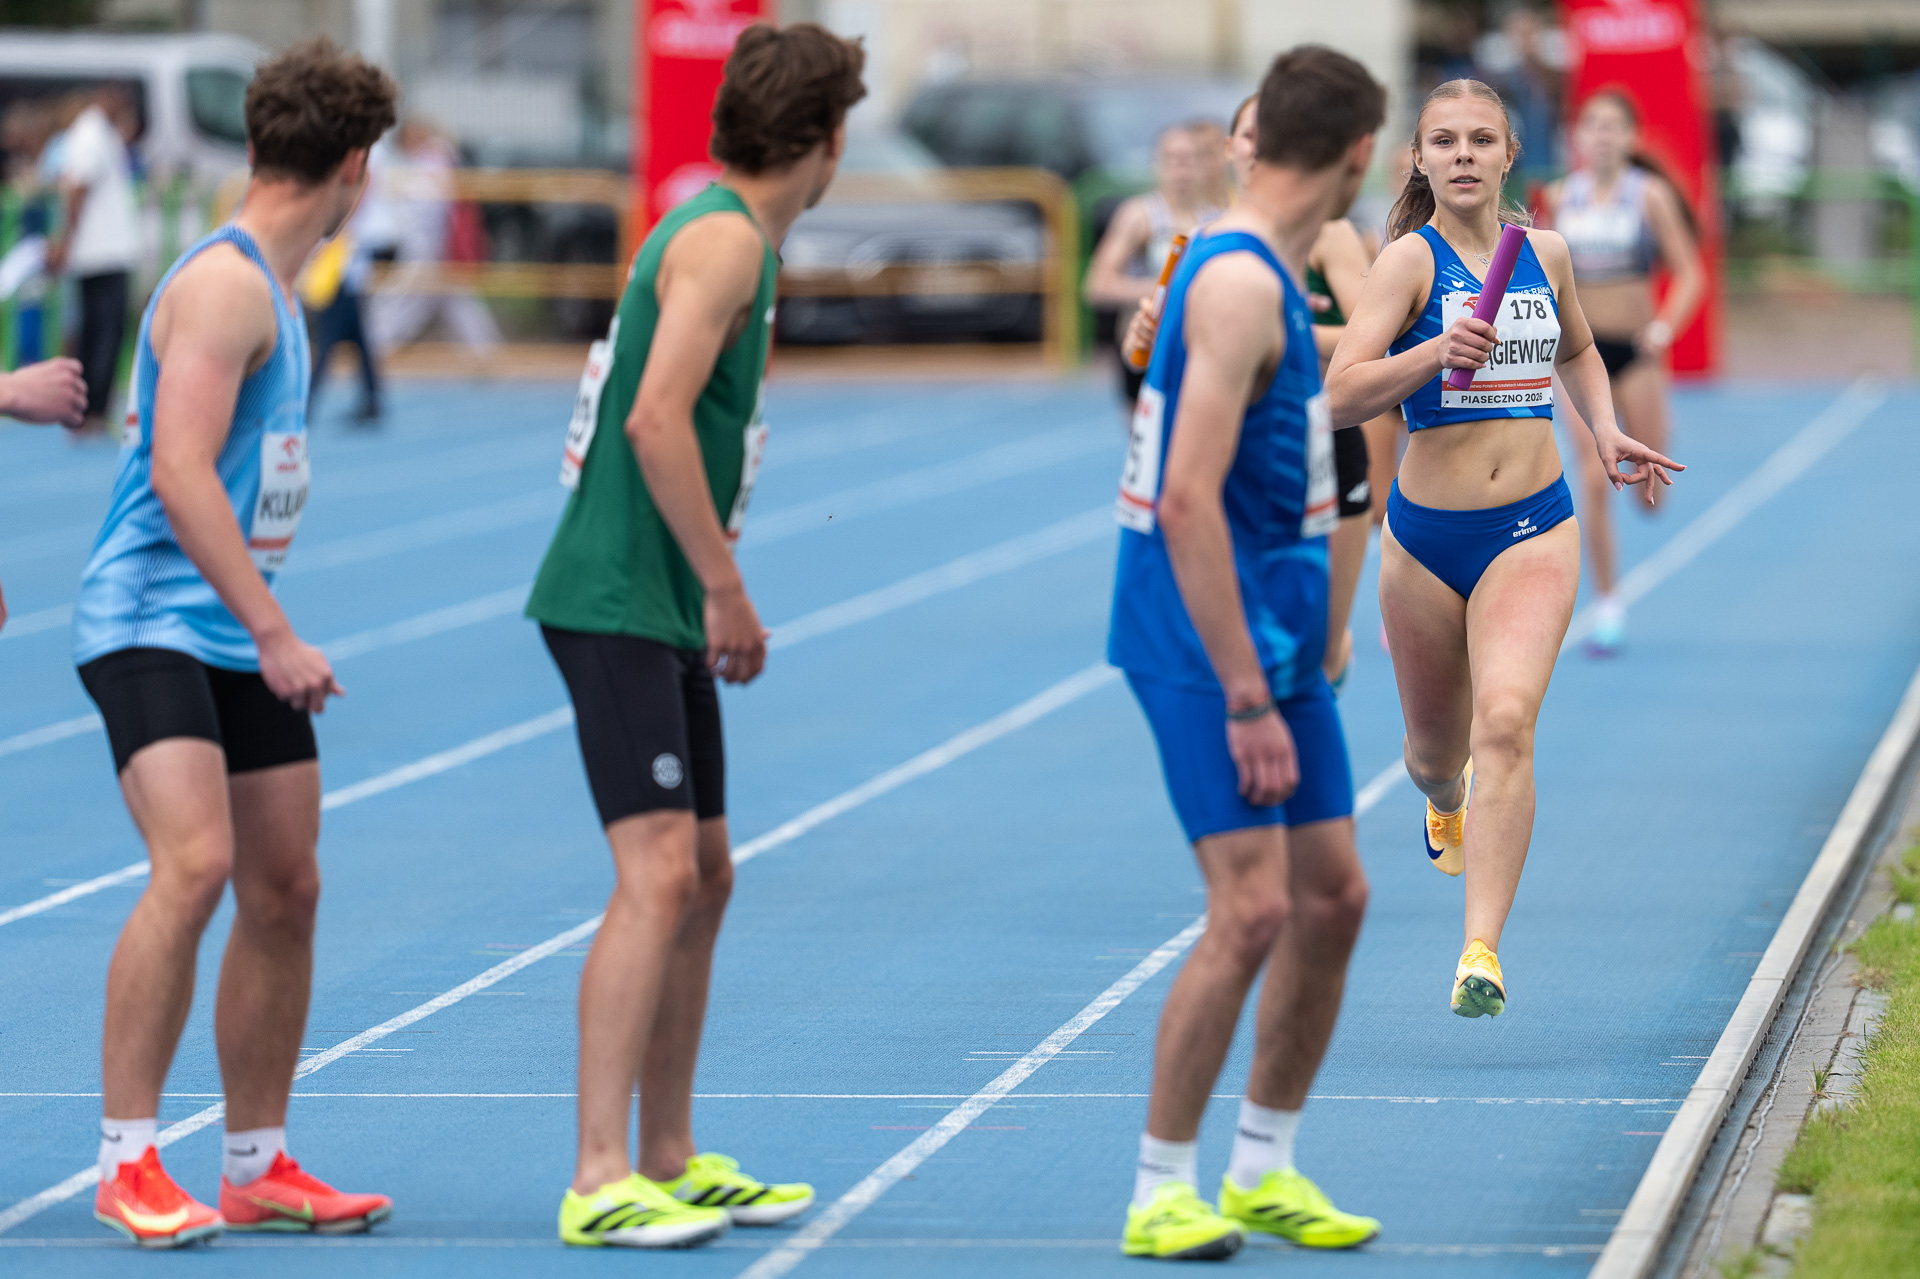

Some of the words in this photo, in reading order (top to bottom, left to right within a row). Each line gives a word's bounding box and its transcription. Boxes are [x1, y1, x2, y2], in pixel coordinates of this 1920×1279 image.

[1510, 299, 1547, 320] 178
[1461, 394, 1523, 404] PIASECZNO
[1512, 525, 1538, 538] erima
